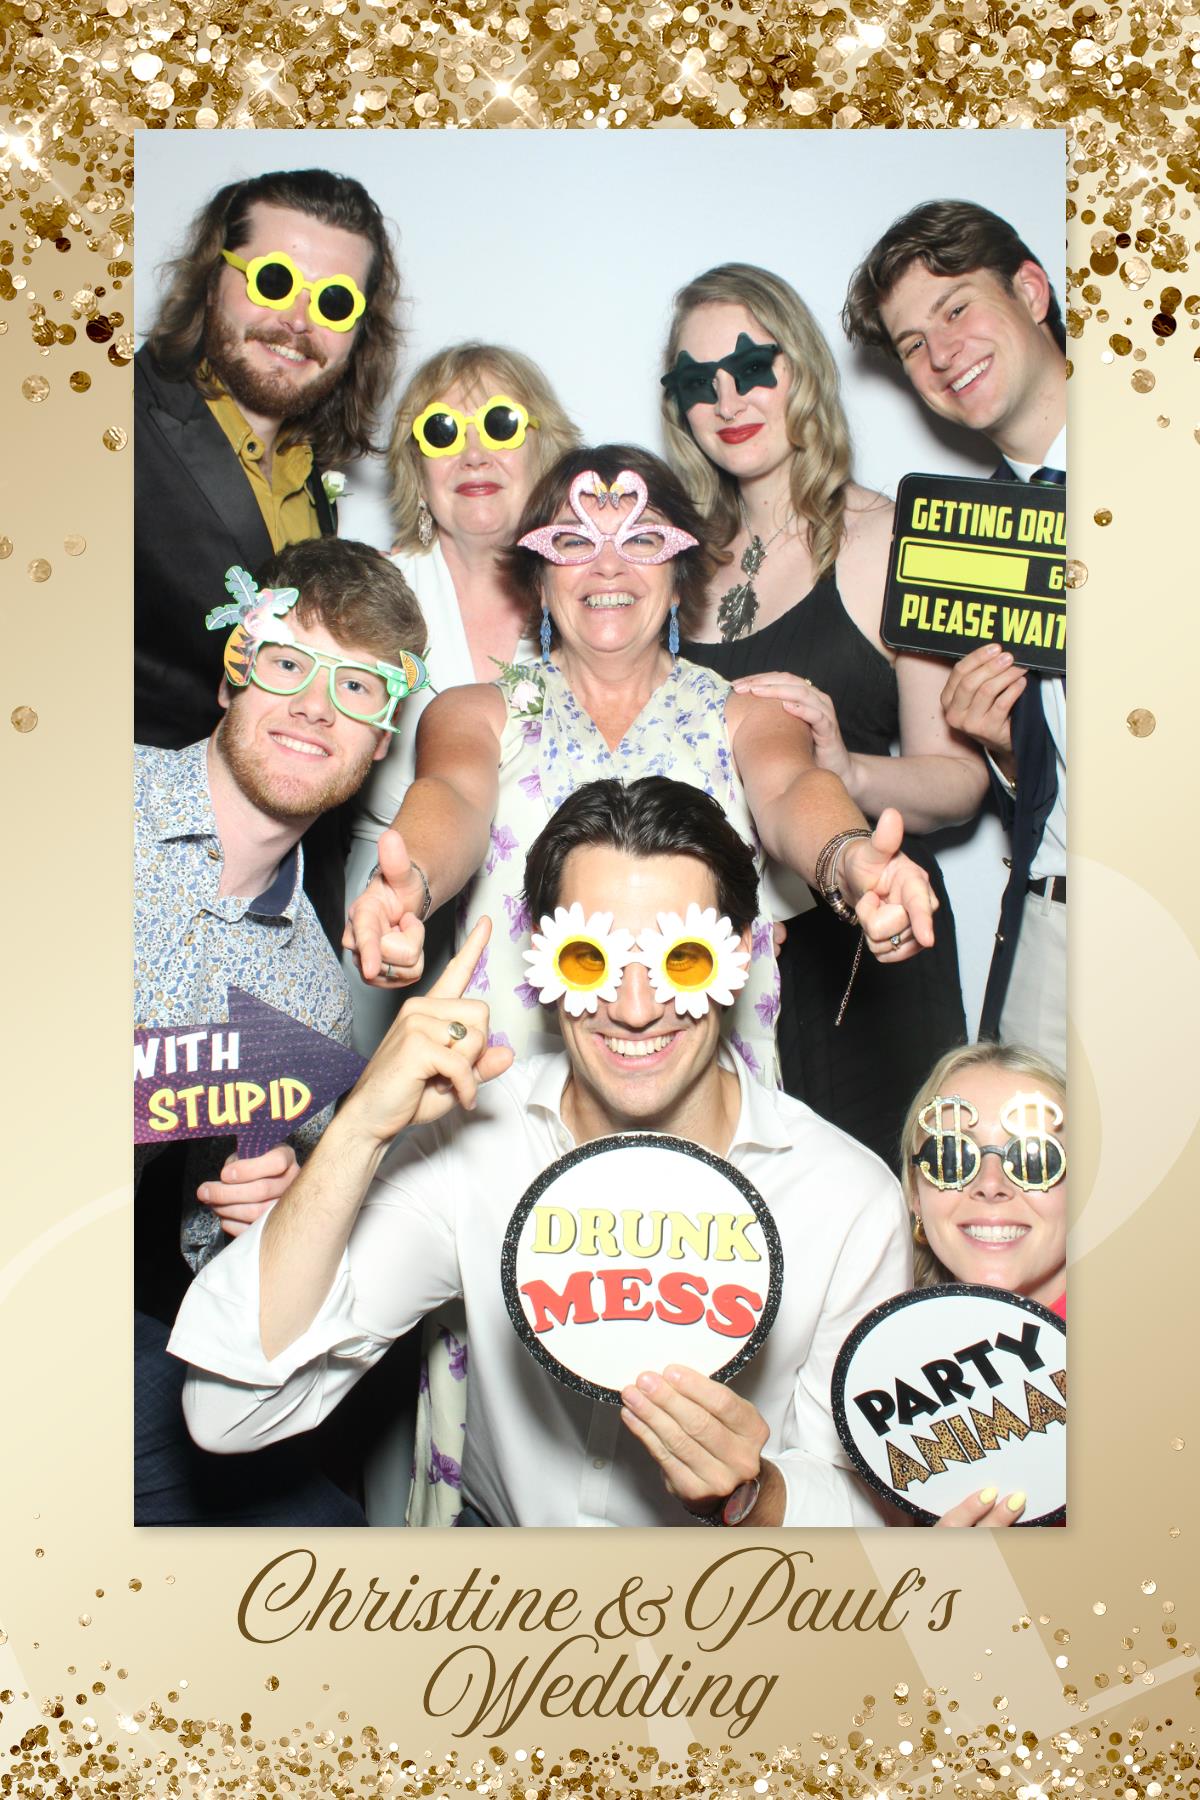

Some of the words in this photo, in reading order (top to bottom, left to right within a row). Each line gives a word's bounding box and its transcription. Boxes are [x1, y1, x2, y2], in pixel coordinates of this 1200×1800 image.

[911, 497, 1013, 540] GETTING
[1048, 565, 1066, 590] 6
[900, 593, 998, 640] PLEASE
[1002, 606, 1066, 650] WAIT
[134, 1032, 240, 1080] WITH
[148, 1077, 312, 1132] STUPID
[530, 1206, 762, 1262] DRUNK
[520, 1268, 763, 1338] MESS
[853, 1322, 1046, 1437] PARTY
